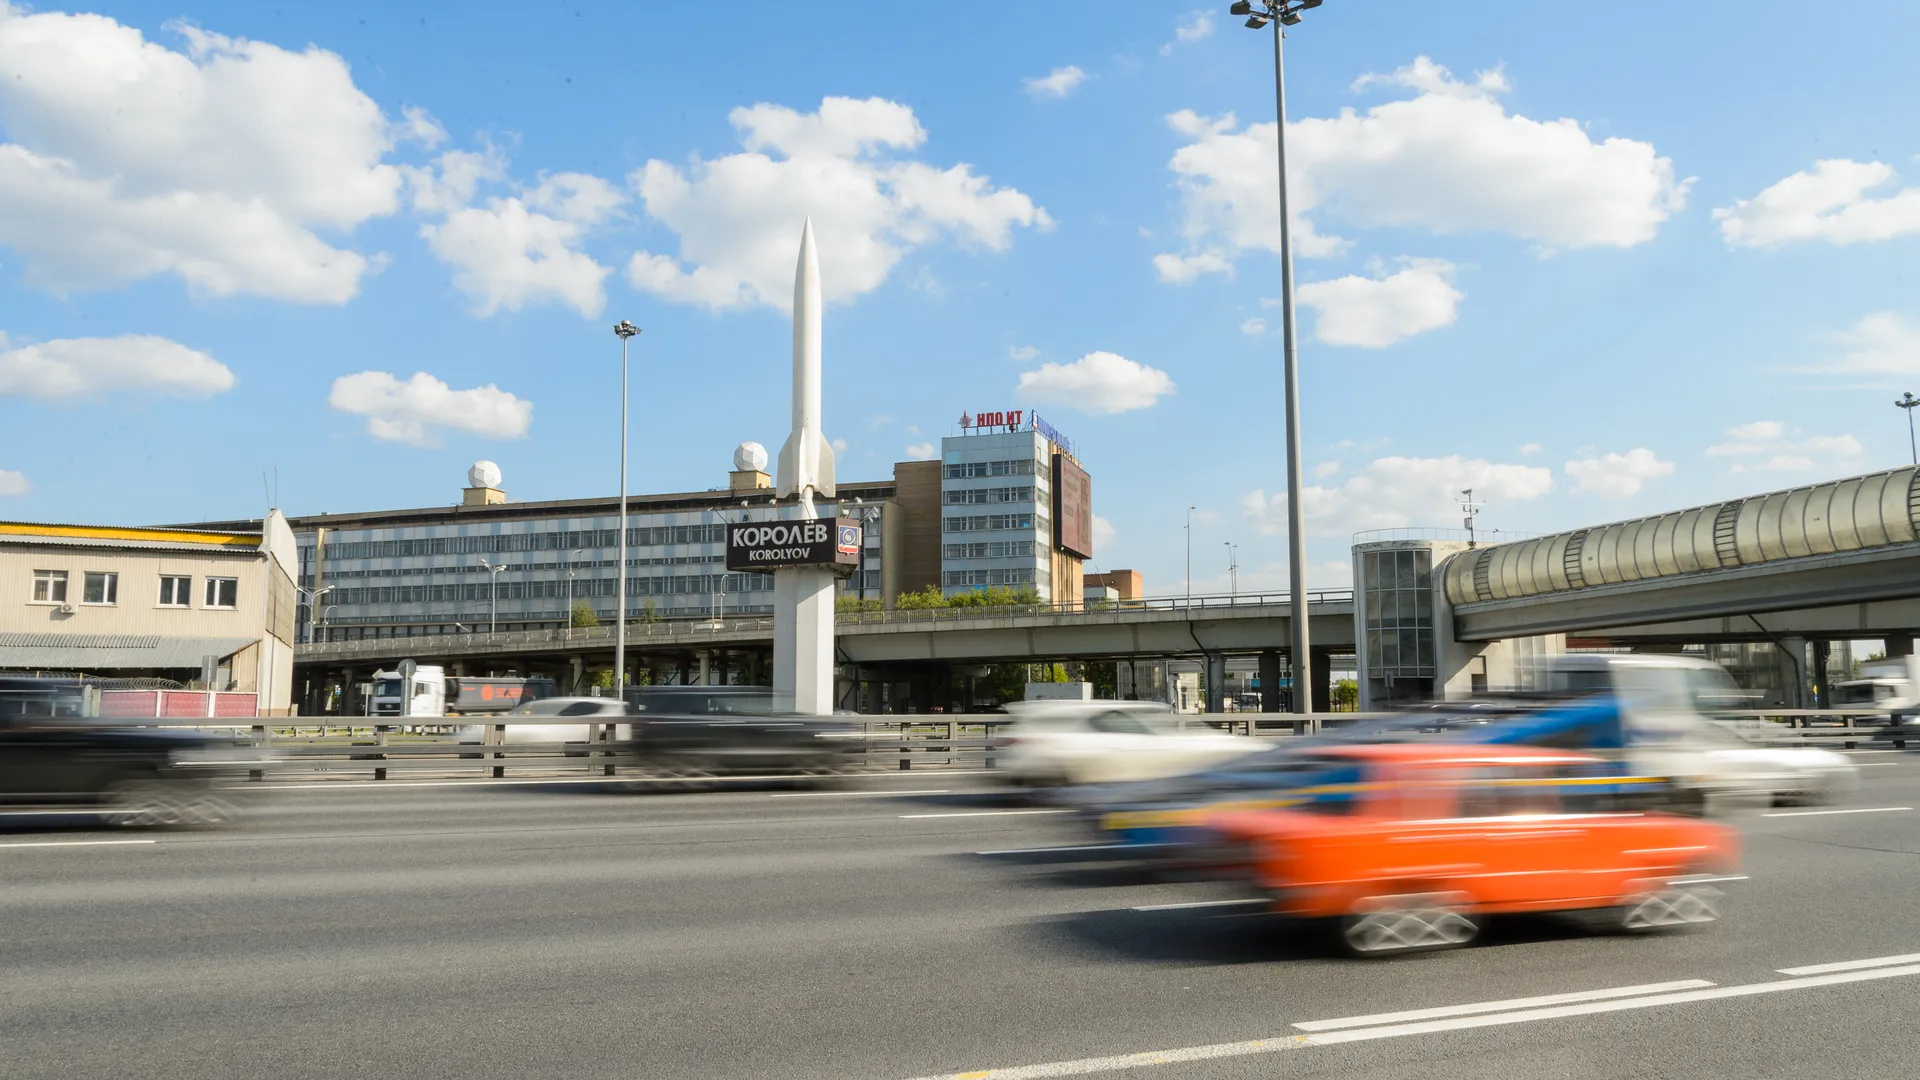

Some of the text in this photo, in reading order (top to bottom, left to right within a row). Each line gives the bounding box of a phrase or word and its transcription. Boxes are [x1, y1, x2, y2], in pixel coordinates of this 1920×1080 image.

[977, 410, 1022, 427] НПО ИТ
[733, 520, 828, 547] КОРОЛЁВ
[749, 547, 811, 561] KOROLYOV
